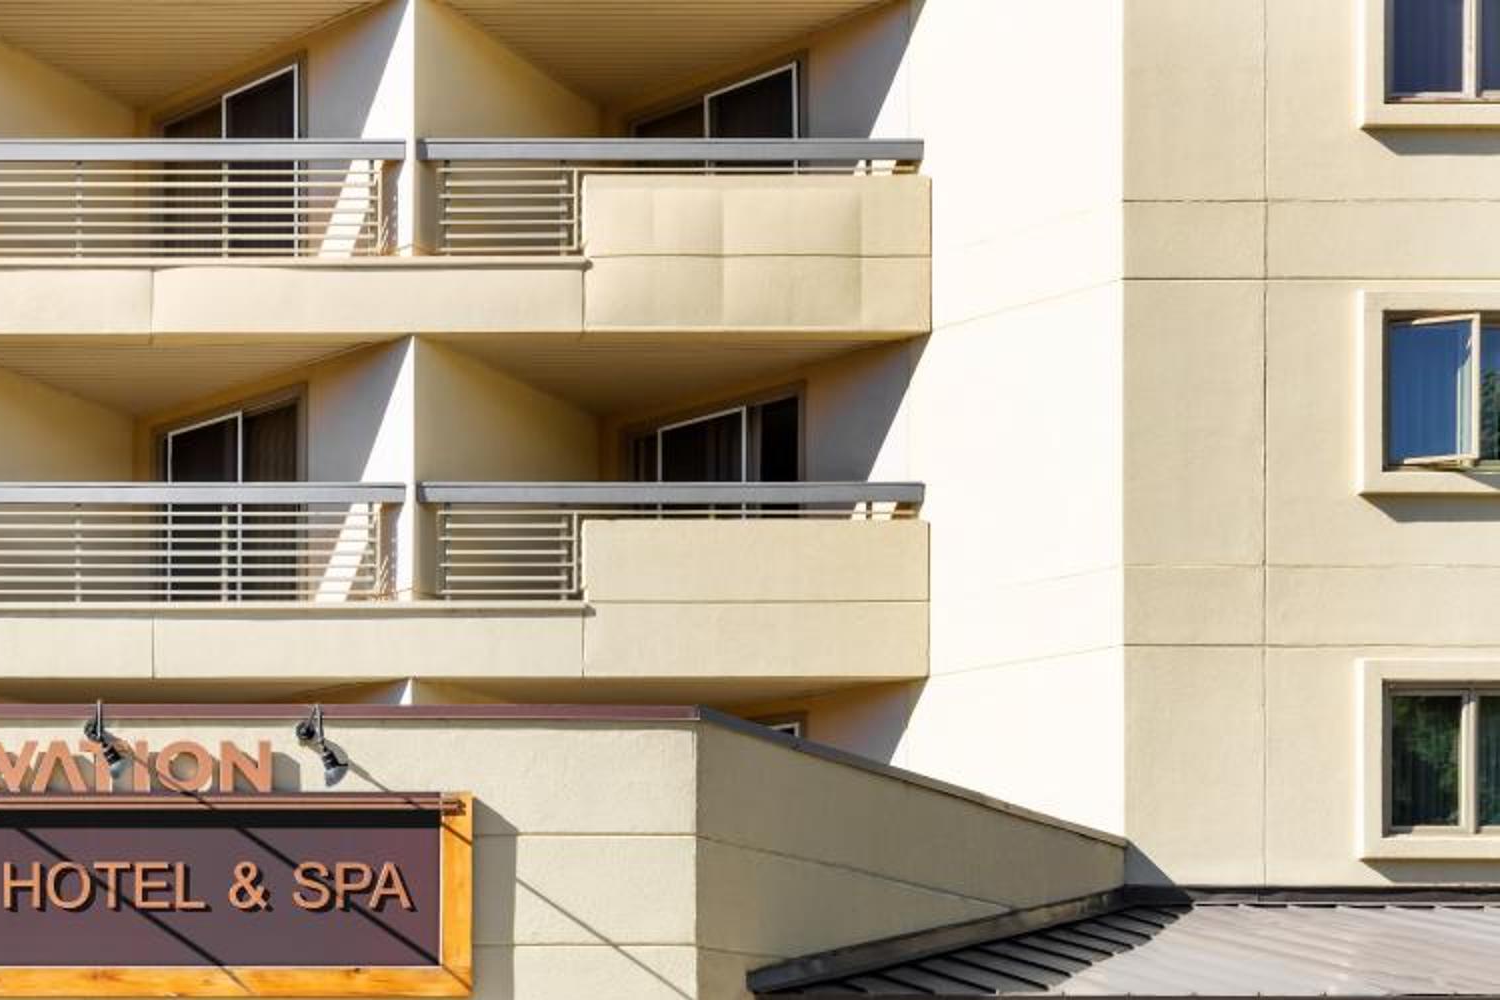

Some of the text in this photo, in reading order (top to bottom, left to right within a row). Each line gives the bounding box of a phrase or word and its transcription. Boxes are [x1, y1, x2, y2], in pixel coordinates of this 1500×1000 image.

[2, 861, 414, 910] HOTEL & SPA
